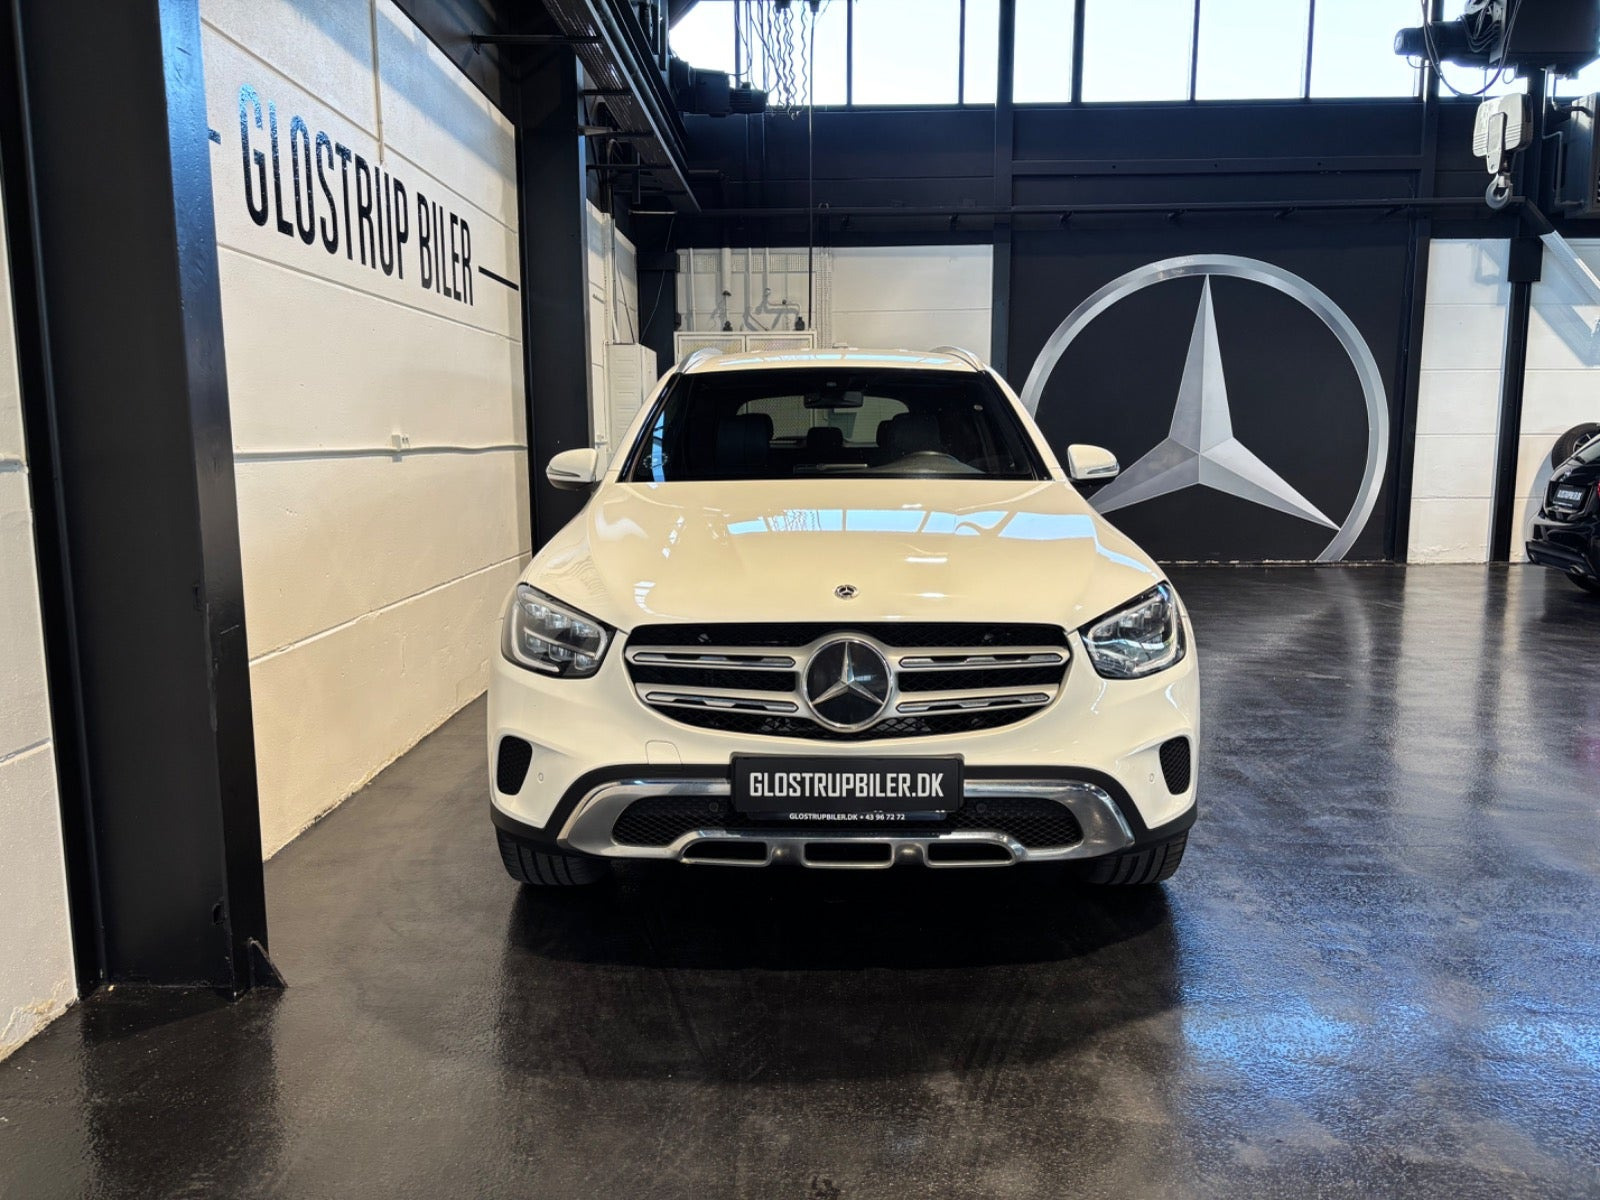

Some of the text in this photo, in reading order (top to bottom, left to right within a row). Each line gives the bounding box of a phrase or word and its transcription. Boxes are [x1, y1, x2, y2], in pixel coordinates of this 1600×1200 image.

[239, 83, 474, 306] GLOSTRUP BILER
[750, 772, 943, 797] GLOSTRUPBILER.DK
[789, 813, 858, 821] GLOSTRUPBILER.DK
